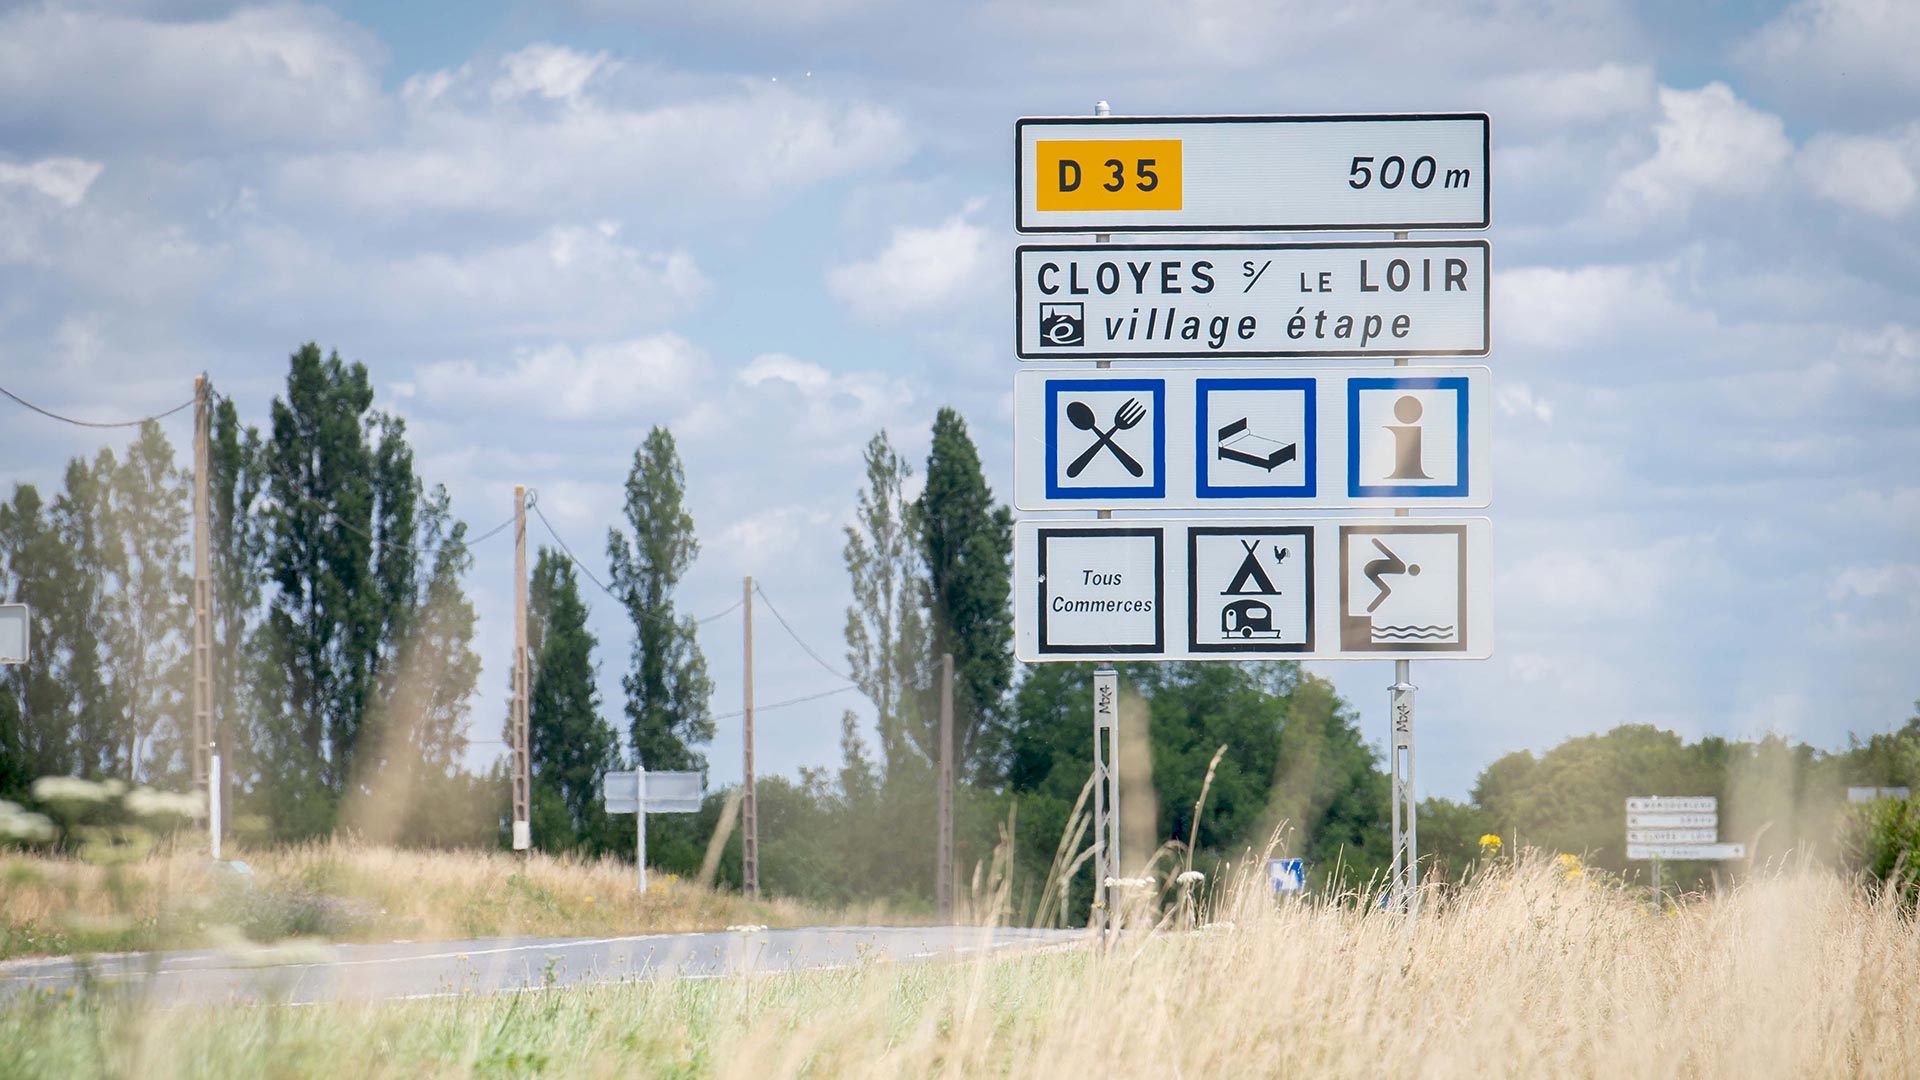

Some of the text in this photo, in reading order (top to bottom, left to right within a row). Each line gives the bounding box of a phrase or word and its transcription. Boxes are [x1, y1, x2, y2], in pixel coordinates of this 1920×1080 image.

[1058, 158, 1159, 193] D 35
[1037, 260, 1215, 296] CLOYES
[1300, 271, 1333, 293] LE
[1360, 258, 1468, 293] LOIR
[1105, 306, 1412, 350] village étape
[1082, 569, 1122, 586] Tous
[1052, 596, 1153, 613] Commerces
